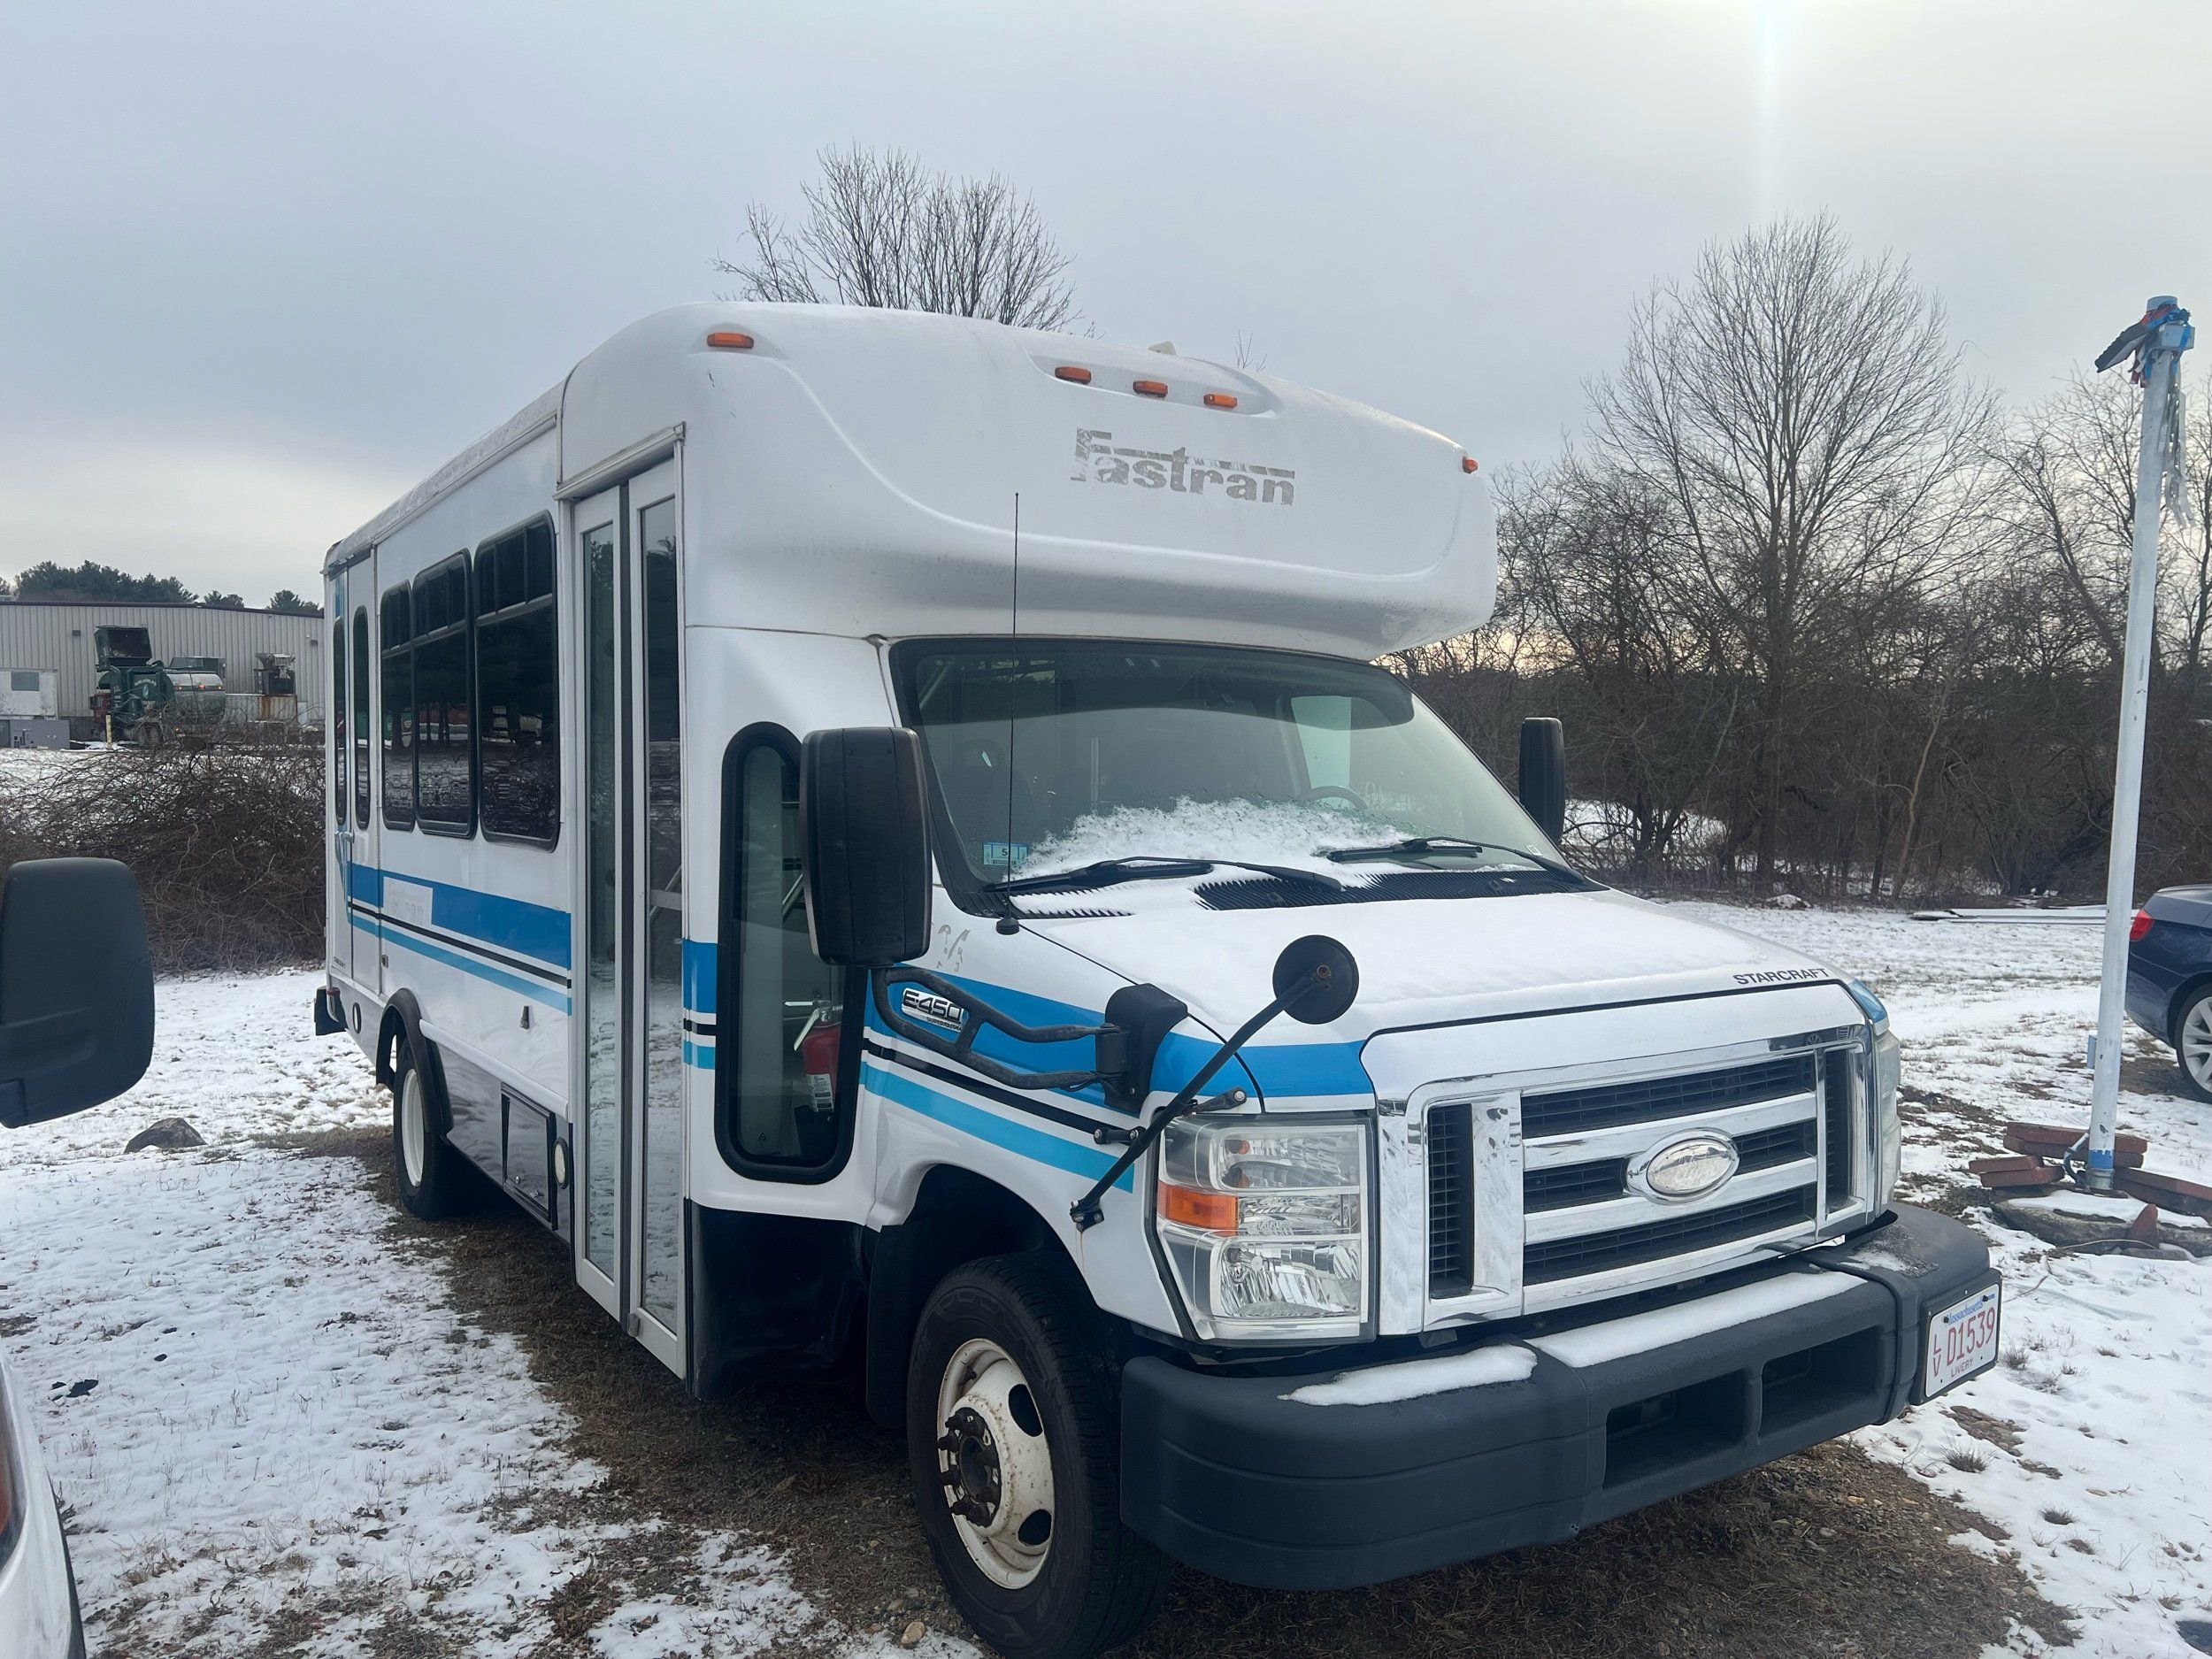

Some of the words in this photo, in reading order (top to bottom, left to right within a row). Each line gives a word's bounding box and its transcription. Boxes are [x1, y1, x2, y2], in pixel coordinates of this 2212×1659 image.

[1071, 427, 1295, 506] Fastran
[1733, 968, 1829, 985] STARCRAFT
[1947, 1307, 1995, 1366] D1539
[1951, 1358, 1974, 1378] LIVERY
